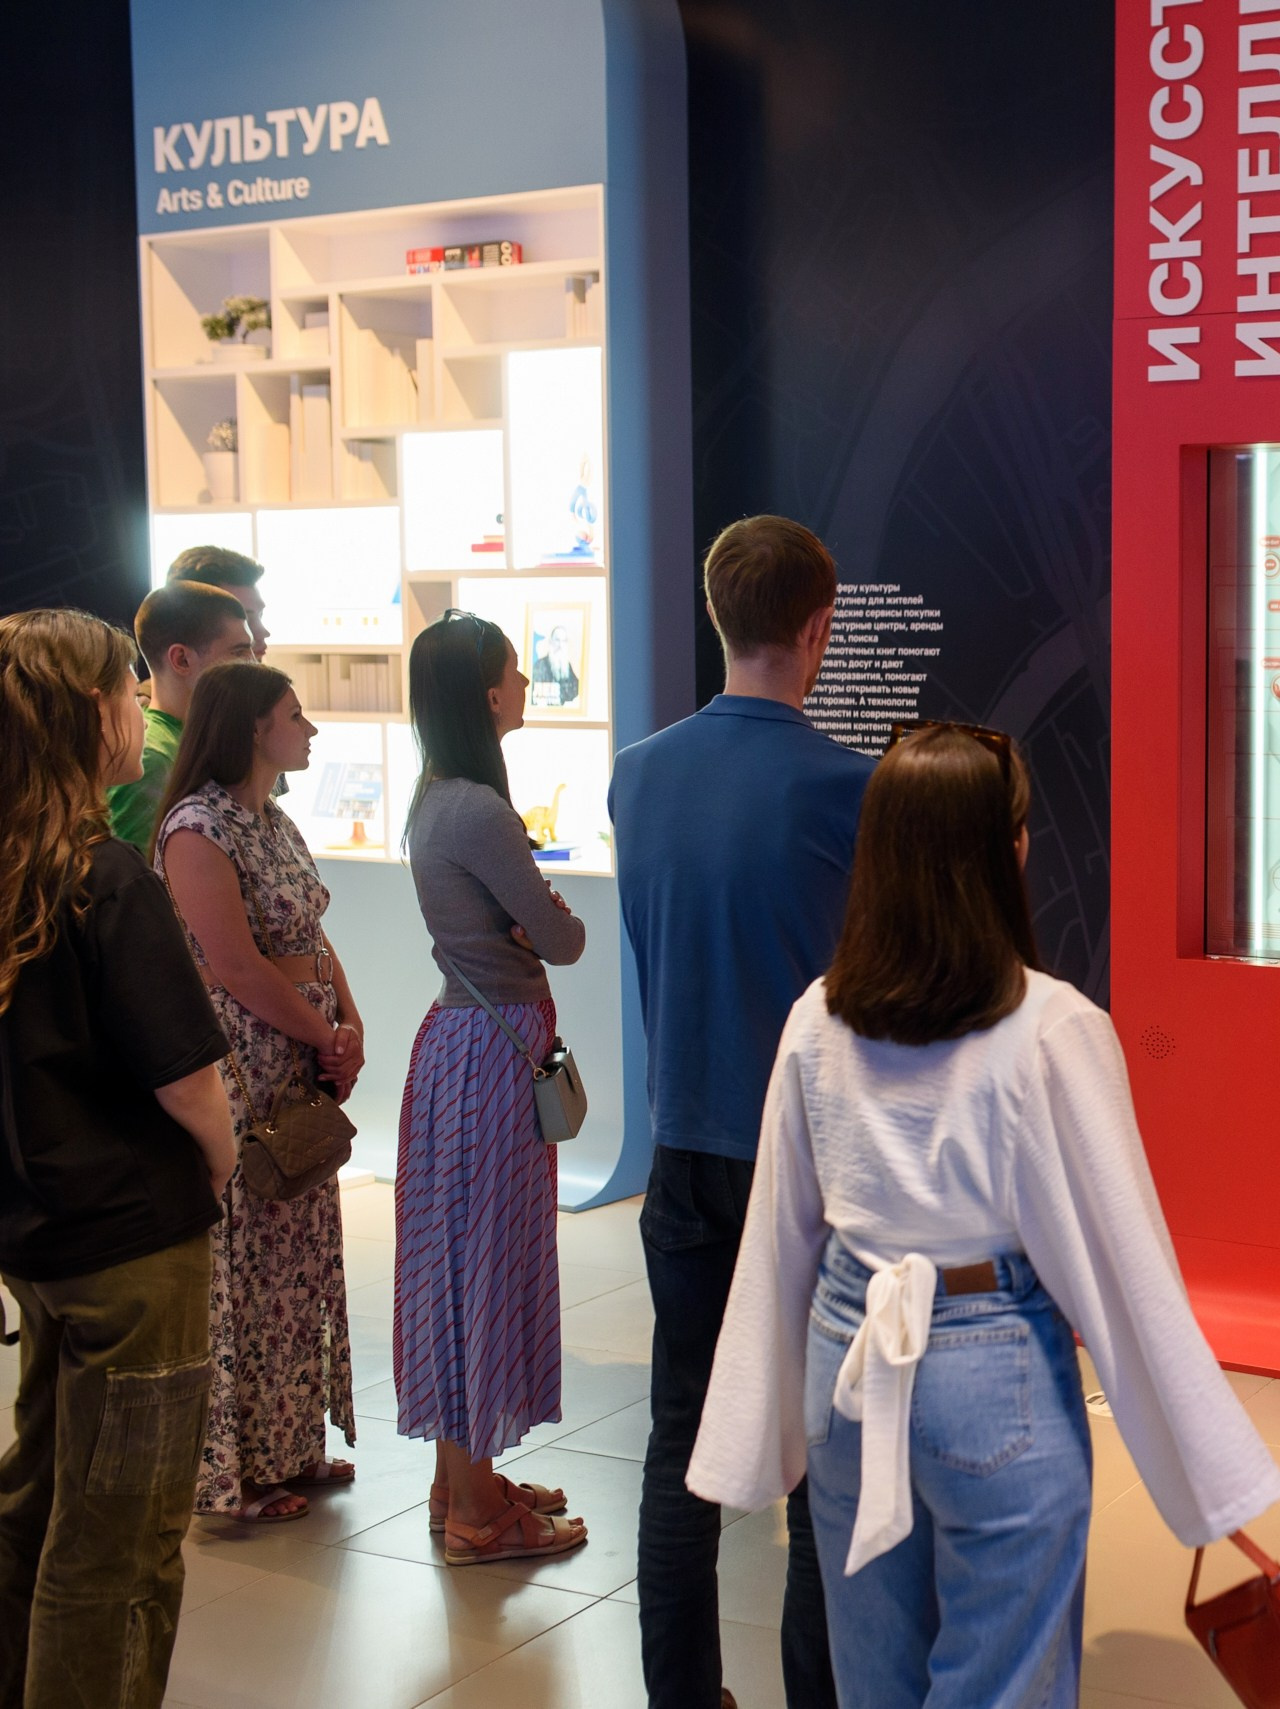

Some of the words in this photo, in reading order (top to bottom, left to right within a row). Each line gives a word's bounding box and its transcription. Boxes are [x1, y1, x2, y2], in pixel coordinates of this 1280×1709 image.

[154, 97, 390, 173] КУЛЬТУРА
[156, 186, 202, 214] Arts
[206, 182, 224, 209] &
[227, 177, 310, 206] Culture
[836, 583, 858, 594] феру
[860, 584, 900, 594] культуры
[868, 596, 884, 606] для
[886, 594, 924, 604] жителей
[833, 610, 864, 618] одские
[865, 610, 902, 619] сервисы
[904, 610, 940, 620] покупки
[831, 622, 872, 632] льтурные
[874, 622, 908, 632] центры,
[910, 622, 944, 632] аренды
[848, 635, 878, 643] поиска
[825, 645, 875, 656] блиотечных
[876, 647, 896, 656] книг
[898, 648, 941, 656] помогают
[848, 660, 873, 670] досуг
[820, 672, 883, 682] саморазвития,
[885, 673, 928, 682] помогают
[846, 686, 891, 695] открывать
[892, 686, 920, 694] новые
[819, 697, 858, 707] горожан.
[868, 698, 917, 706] технологии
[860, 711, 919, 720] современные
[812, 722, 852, 730] тавления
[853, 723, 892, 732] контента
